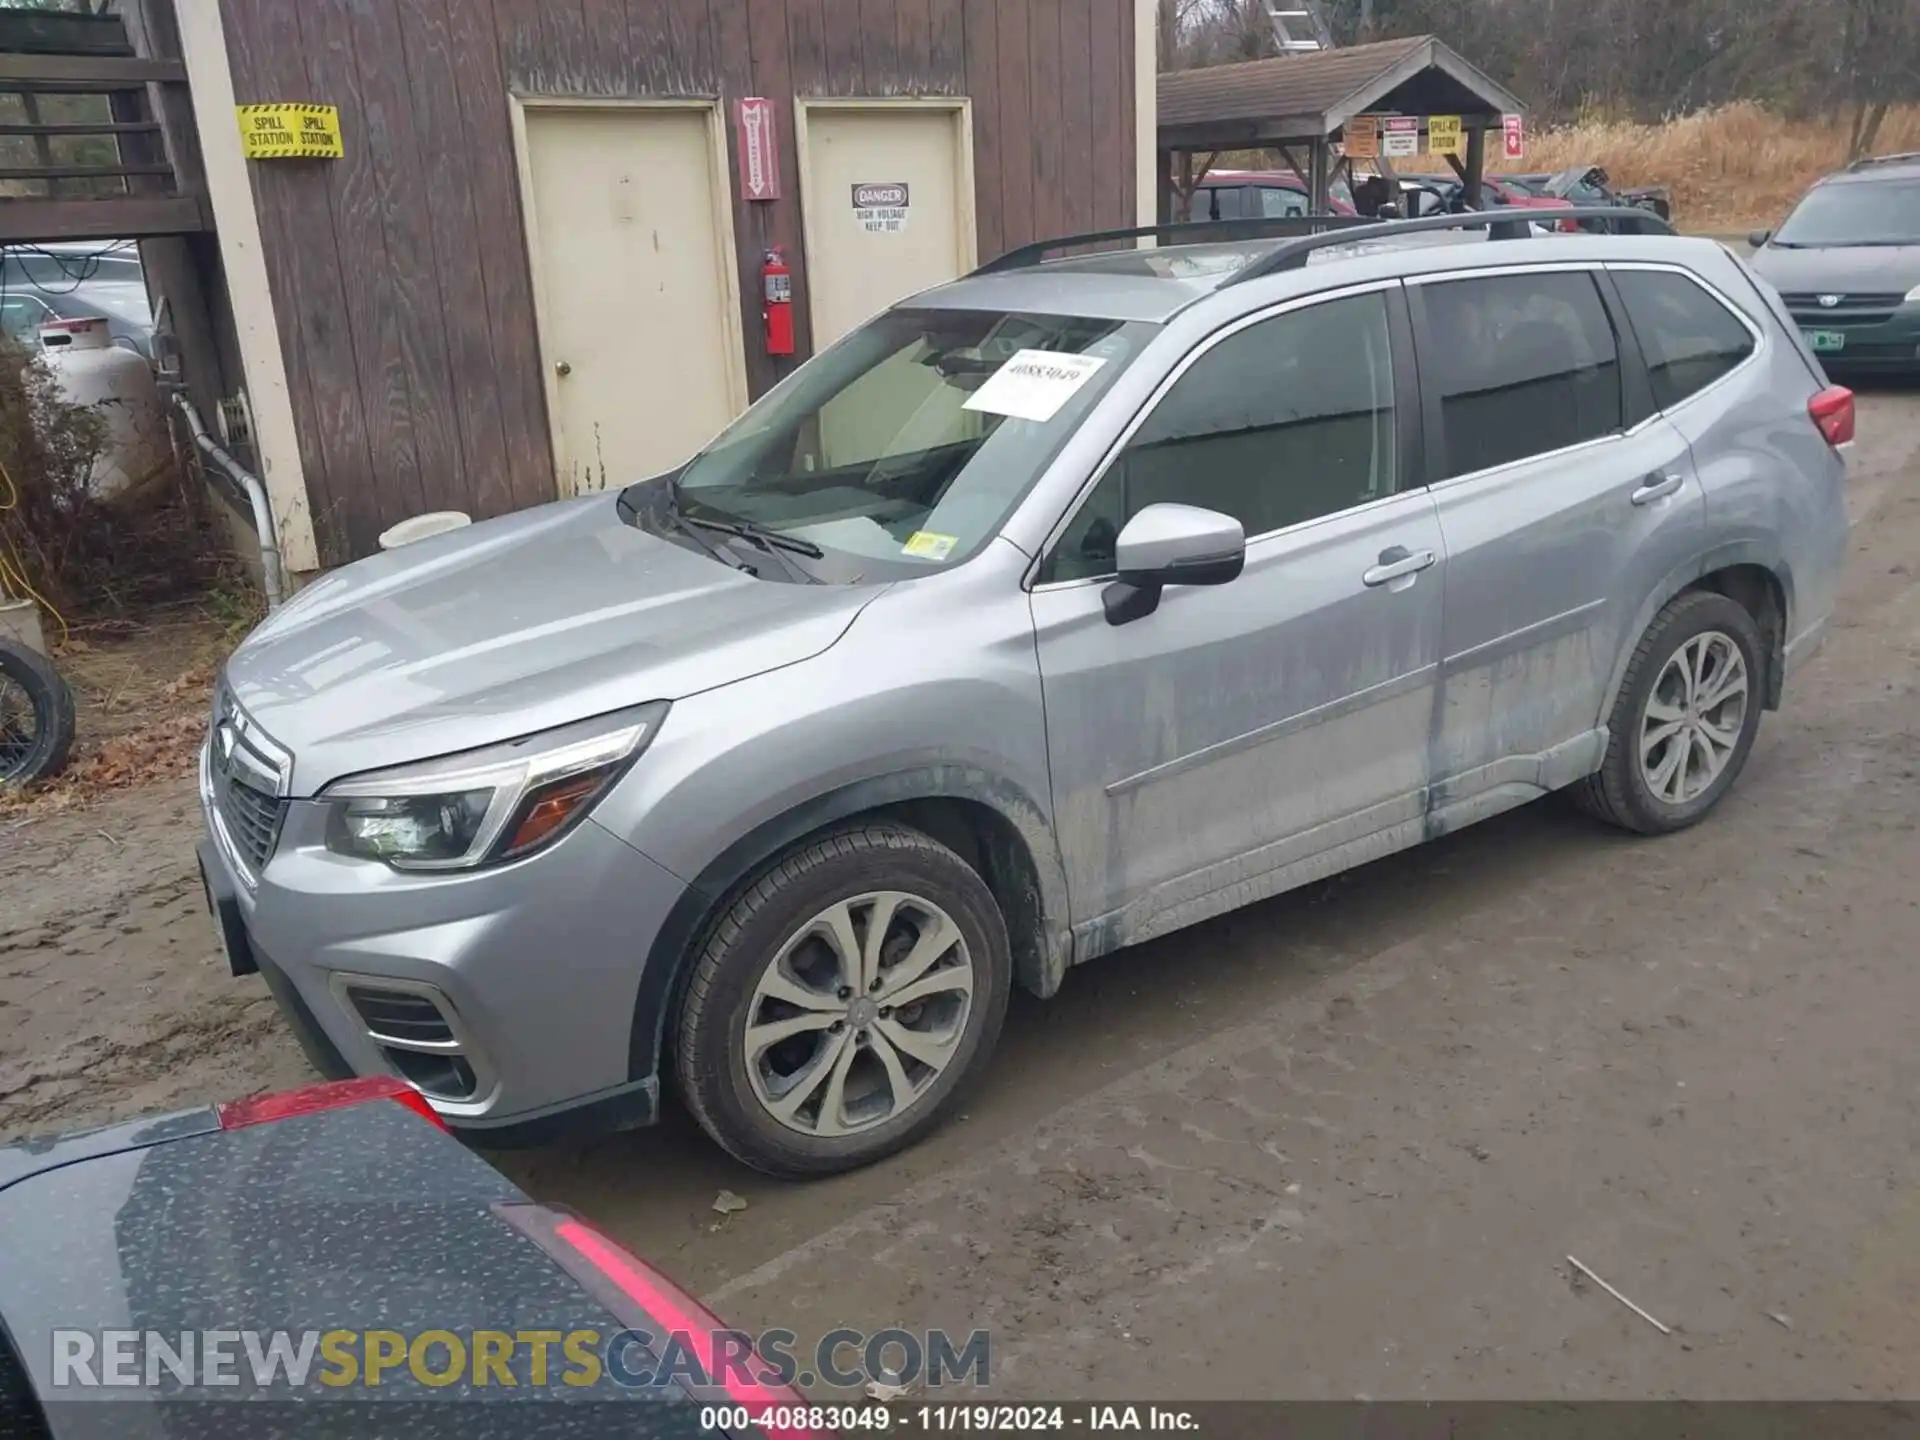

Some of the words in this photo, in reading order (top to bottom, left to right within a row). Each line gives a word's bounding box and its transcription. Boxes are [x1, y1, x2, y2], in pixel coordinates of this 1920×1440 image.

[254, 116, 285, 130] SPILL
[303, 116, 326, 130] SPILL
[249, 132, 294, 146] STATION
[300, 132, 334, 146] STATION
[858, 189, 902, 202] DANGER
[856, 208, 874, 219] HIGH
[865, 220, 882, 231] KEEP
[886, 220, 899, 231] OUT
